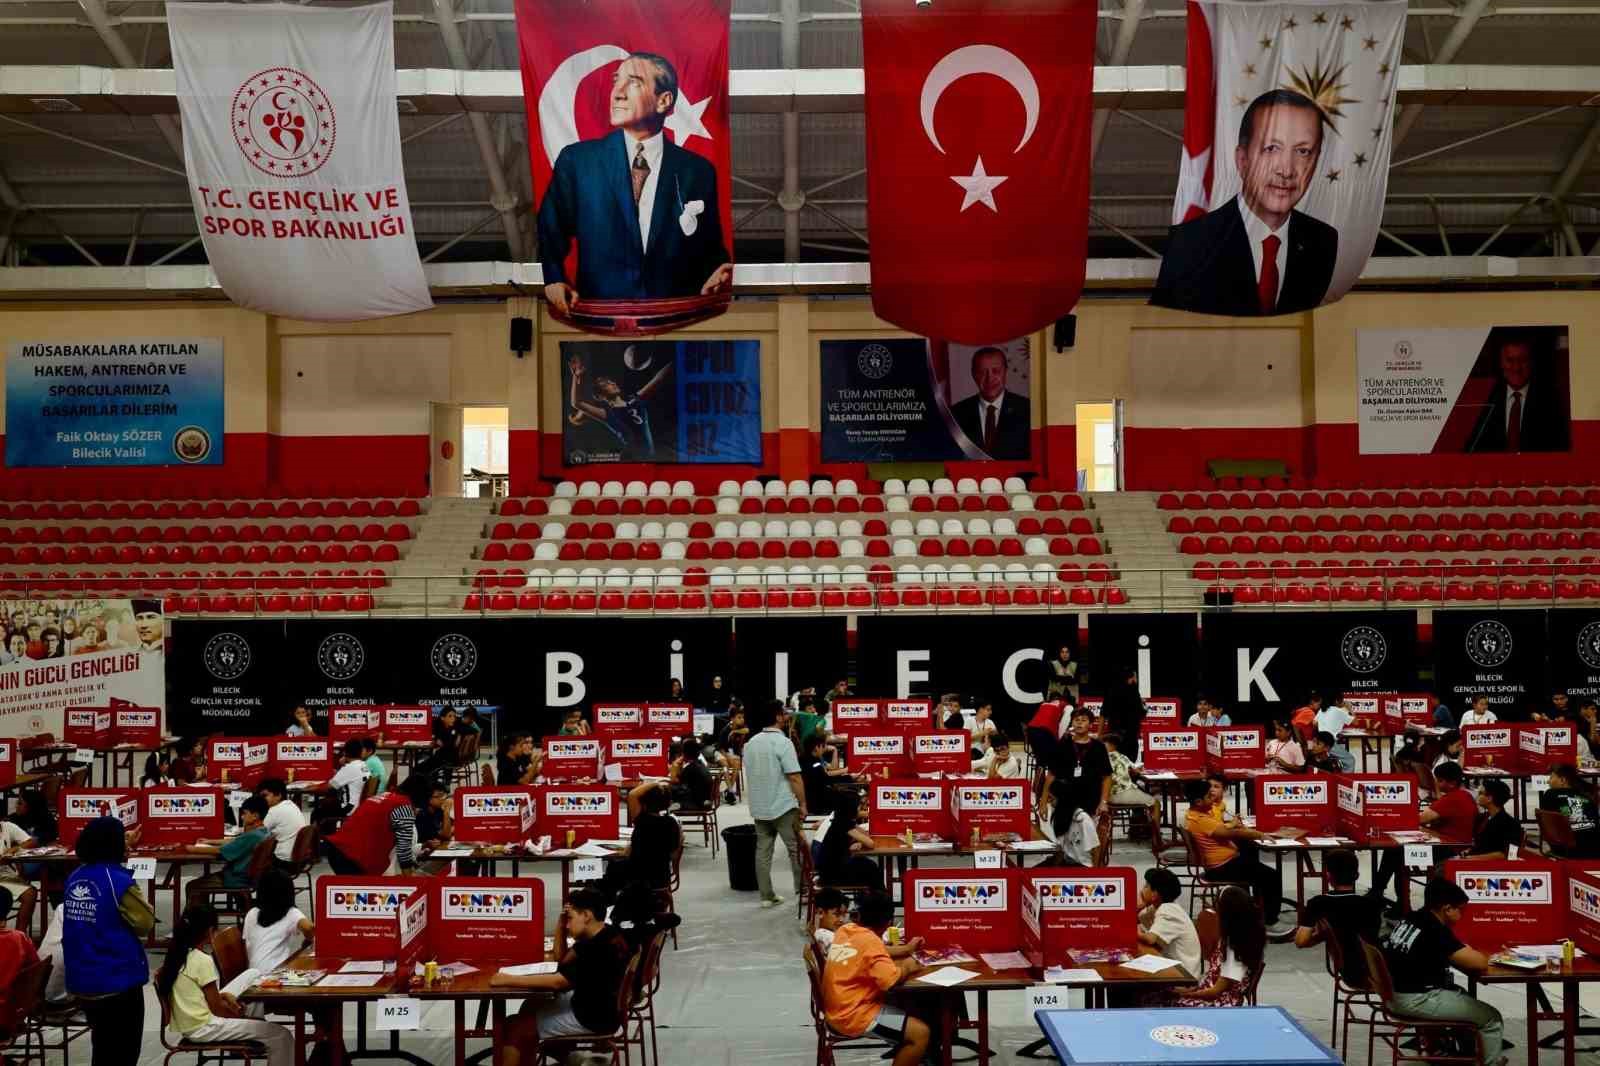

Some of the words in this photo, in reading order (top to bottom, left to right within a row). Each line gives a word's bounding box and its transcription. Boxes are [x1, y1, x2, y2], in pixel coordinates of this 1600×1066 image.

[198, 187, 242, 209] T.C.
[249, 189, 358, 215] GENÇLİK
[365, 188, 399, 210] VE
[204, 216, 266, 238] SPOR
[272, 214, 404, 240] BAKANLIĞI
[22, 344, 137, 357] MÜSABAKALARA
[140, 344, 198, 355] KATILAN
[34, 365, 88, 378] HAKEM,
[91, 363, 166, 376] ANTRENÖR
[169, 364, 186, 375] VE
[49, 384, 170, 397] SPORCULARIMIZA
[57, 431, 81, 442] Faik
[84, 431, 119, 444] Oktay
[122, 429, 162, 441] SÖZER
[72, 448, 112, 458] Bilecik
[71, 653, 140, 679] GENÇLİĞİ
[1454, 685, 1486, 694] GENÇLİK
[190, 697, 223, 706] GENÇLİK
[305, 697, 336, 707] GENÇLİK
[1465, 695, 1514, 704] MRLÜĞÜ
[920, 738, 960, 746] DENEYAP
[1153, 735, 1194, 743] DENEYAP
[553, 743, 594, 751] DENEYAP
[617, 742, 658, 750] DENEYAP
[1269, 786, 1322, 795] DENEYAP
[1364, 785, 1405, 794] NEYAP
[883, 791, 936, 800] DENEYAP
[964, 791, 1017, 800] DENEYAP
[154, 799, 210, 808] DENEYAP
[552, 797, 605, 806] DENEYAP
[1464, 878, 1543, 890] DENEYAP
[923, 885, 999, 898] DENEYAP
[1040, 884, 1116, 897] DENEYAP
[334, 892, 409, 905] DENEYAP
[449, 893, 524, 907] DENEYAP
[1033, 996, 1044, 1005] M
[1046, 996, 1057, 1005] 24
[384, 1007, 395, 1016] M
[397, 1006, 409, 1016] 25
